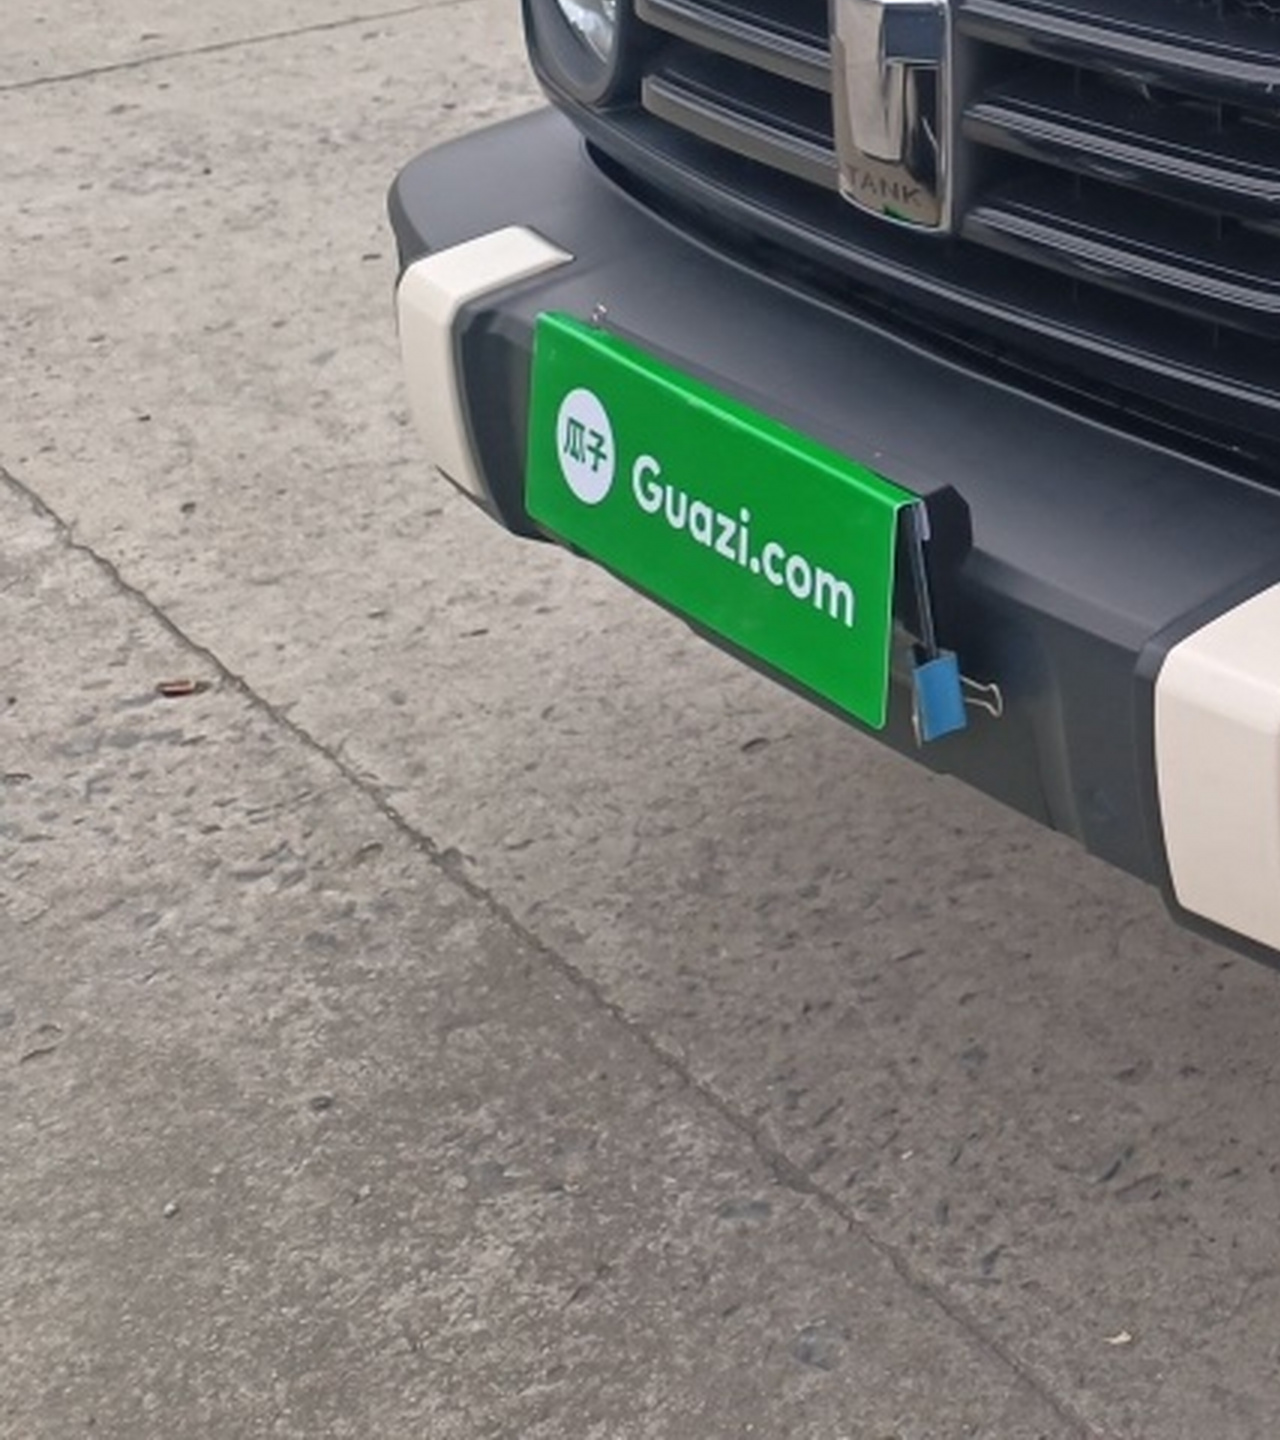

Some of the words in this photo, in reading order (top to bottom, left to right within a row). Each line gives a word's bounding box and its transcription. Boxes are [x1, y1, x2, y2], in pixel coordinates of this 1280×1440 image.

[847, 162, 922, 208] TANK
[563, 417, 608, 472] 瓜子
[631, 455, 855, 628] Guazi.com
